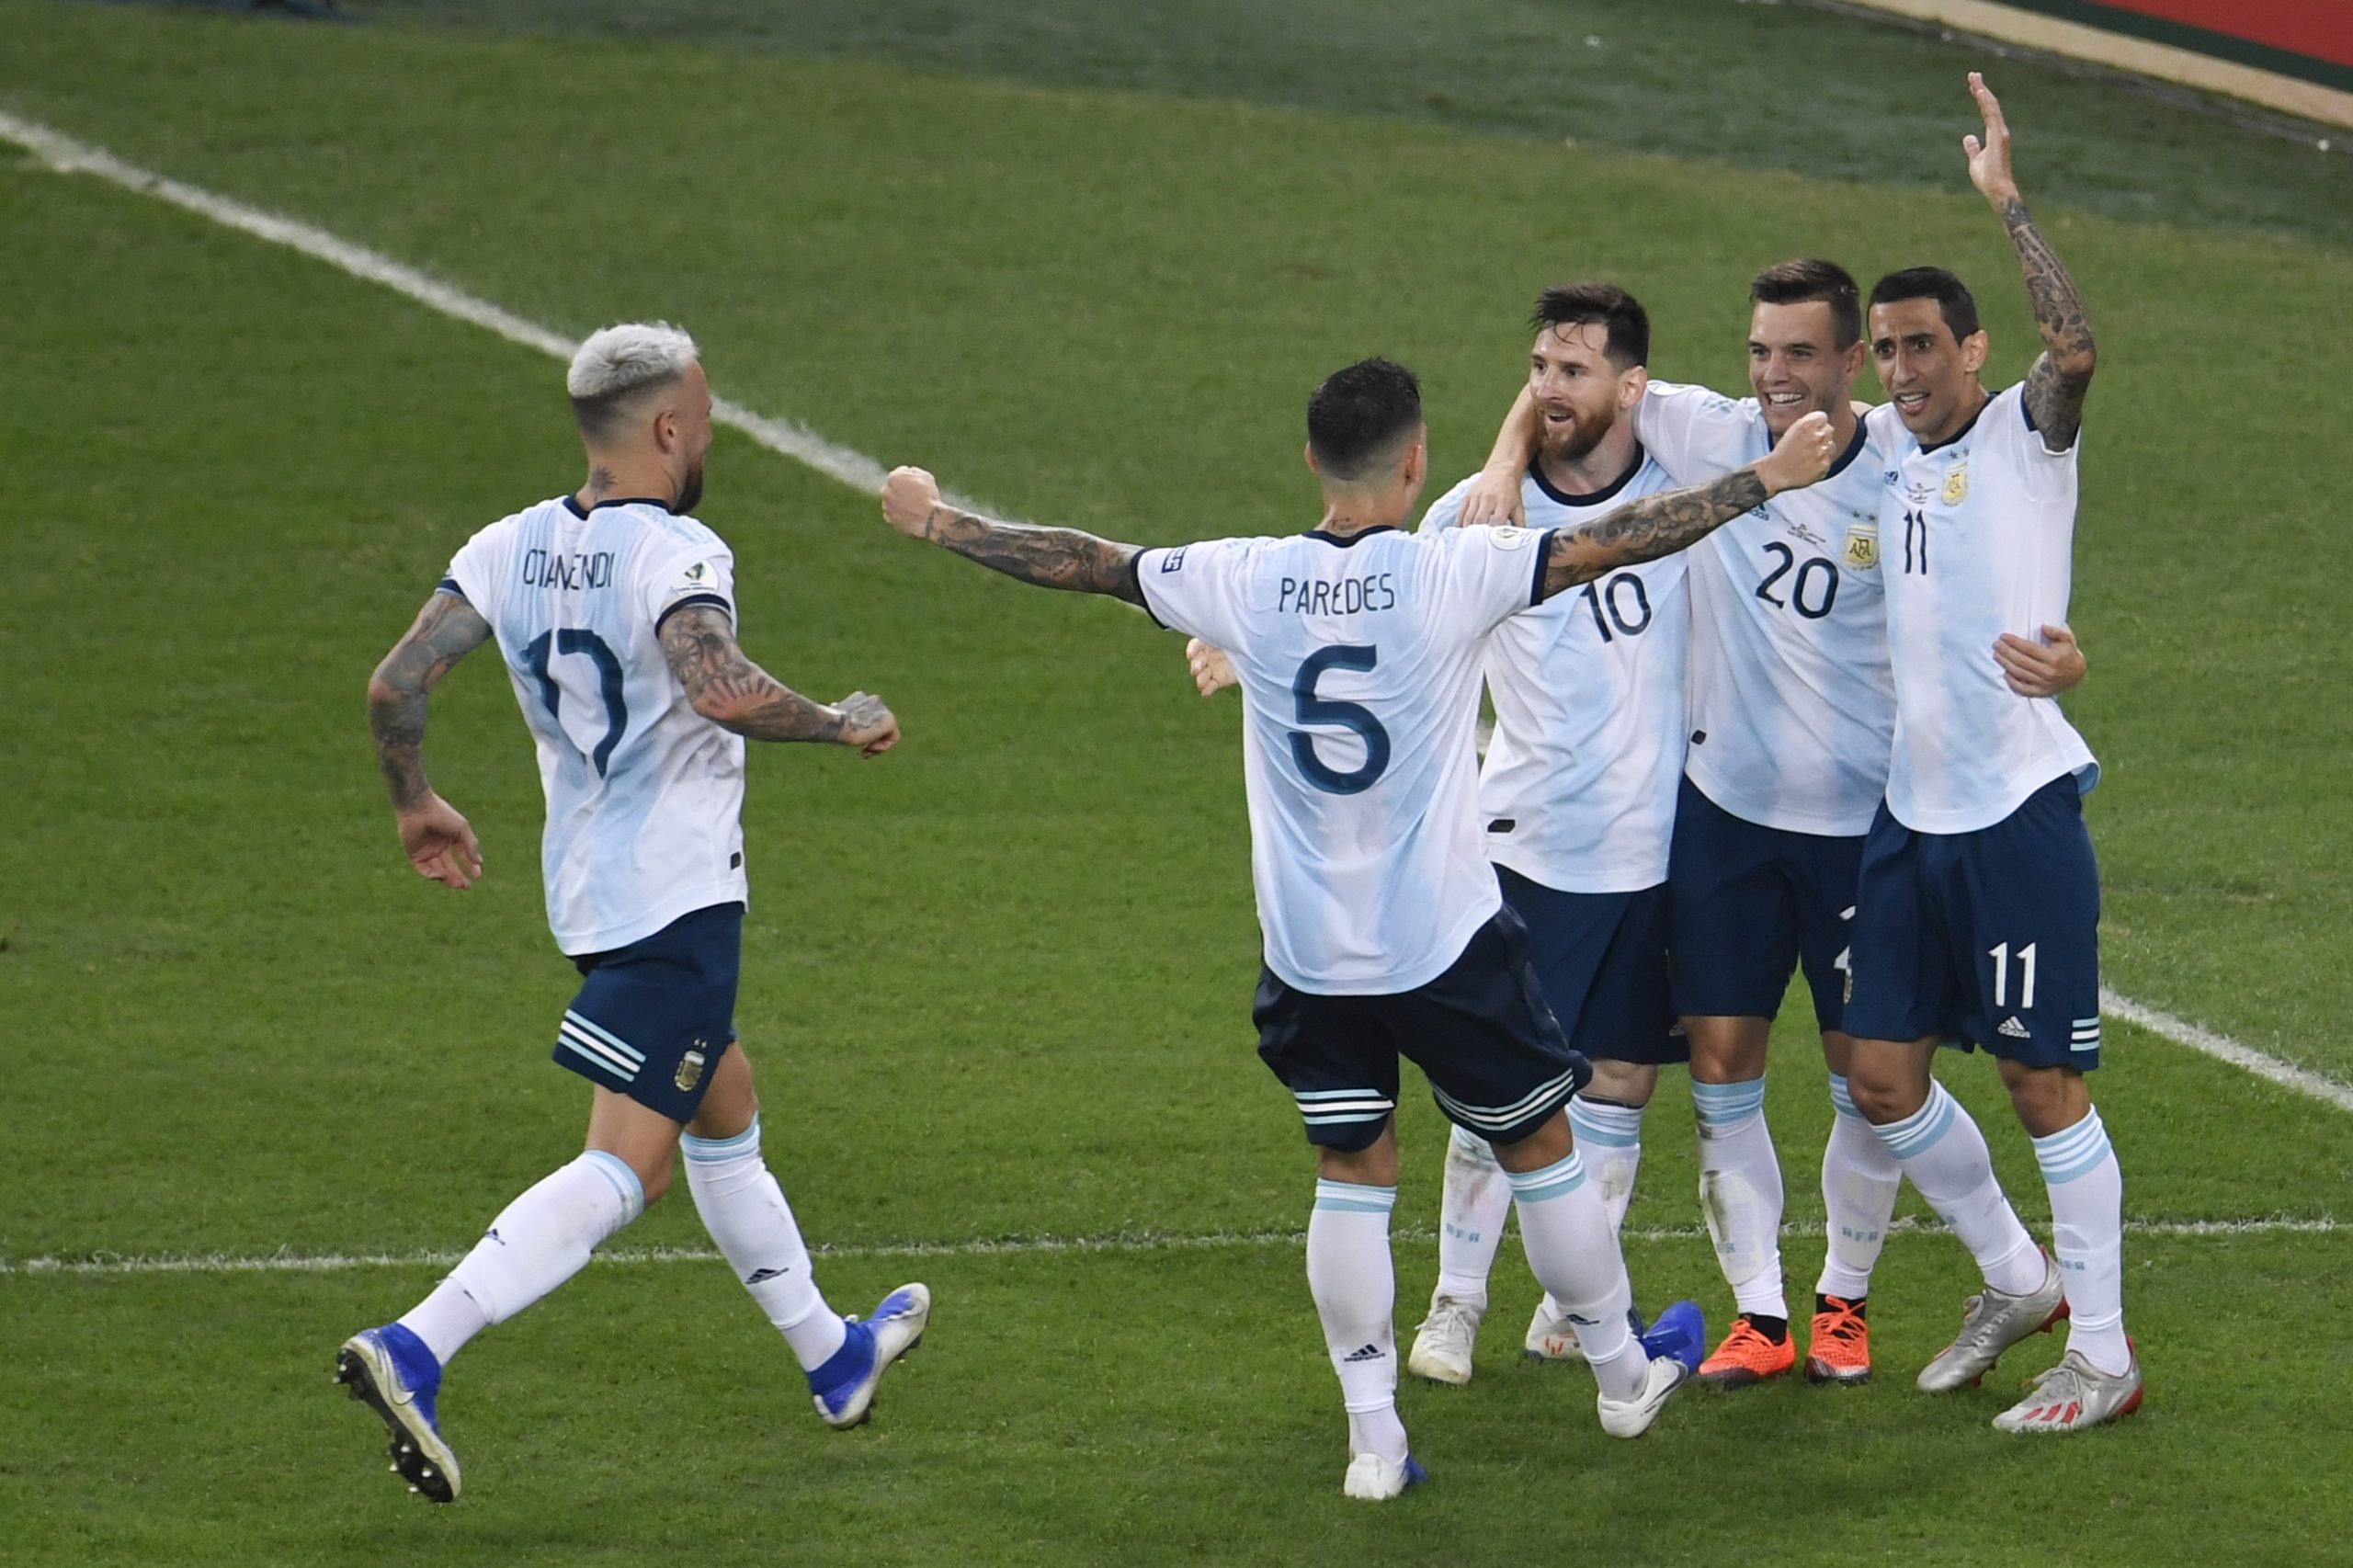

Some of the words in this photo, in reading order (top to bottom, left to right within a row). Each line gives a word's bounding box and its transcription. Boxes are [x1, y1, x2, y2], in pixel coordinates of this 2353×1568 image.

[1849, 537, 1872, 559] AFA
[1903, 509, 1927, 575] 11
[1279, 573, 1395, 617] PAREDES
[1579, 572, 1653, 644] 10
[1755, 540, 1839, 619] 20
[518, 628, 629, 780] 17
[1288, 643, 1392, 796] 5
[1988, 941, 2037, 1010] 11
[1996, 1026, 2031, 1039] adidas
